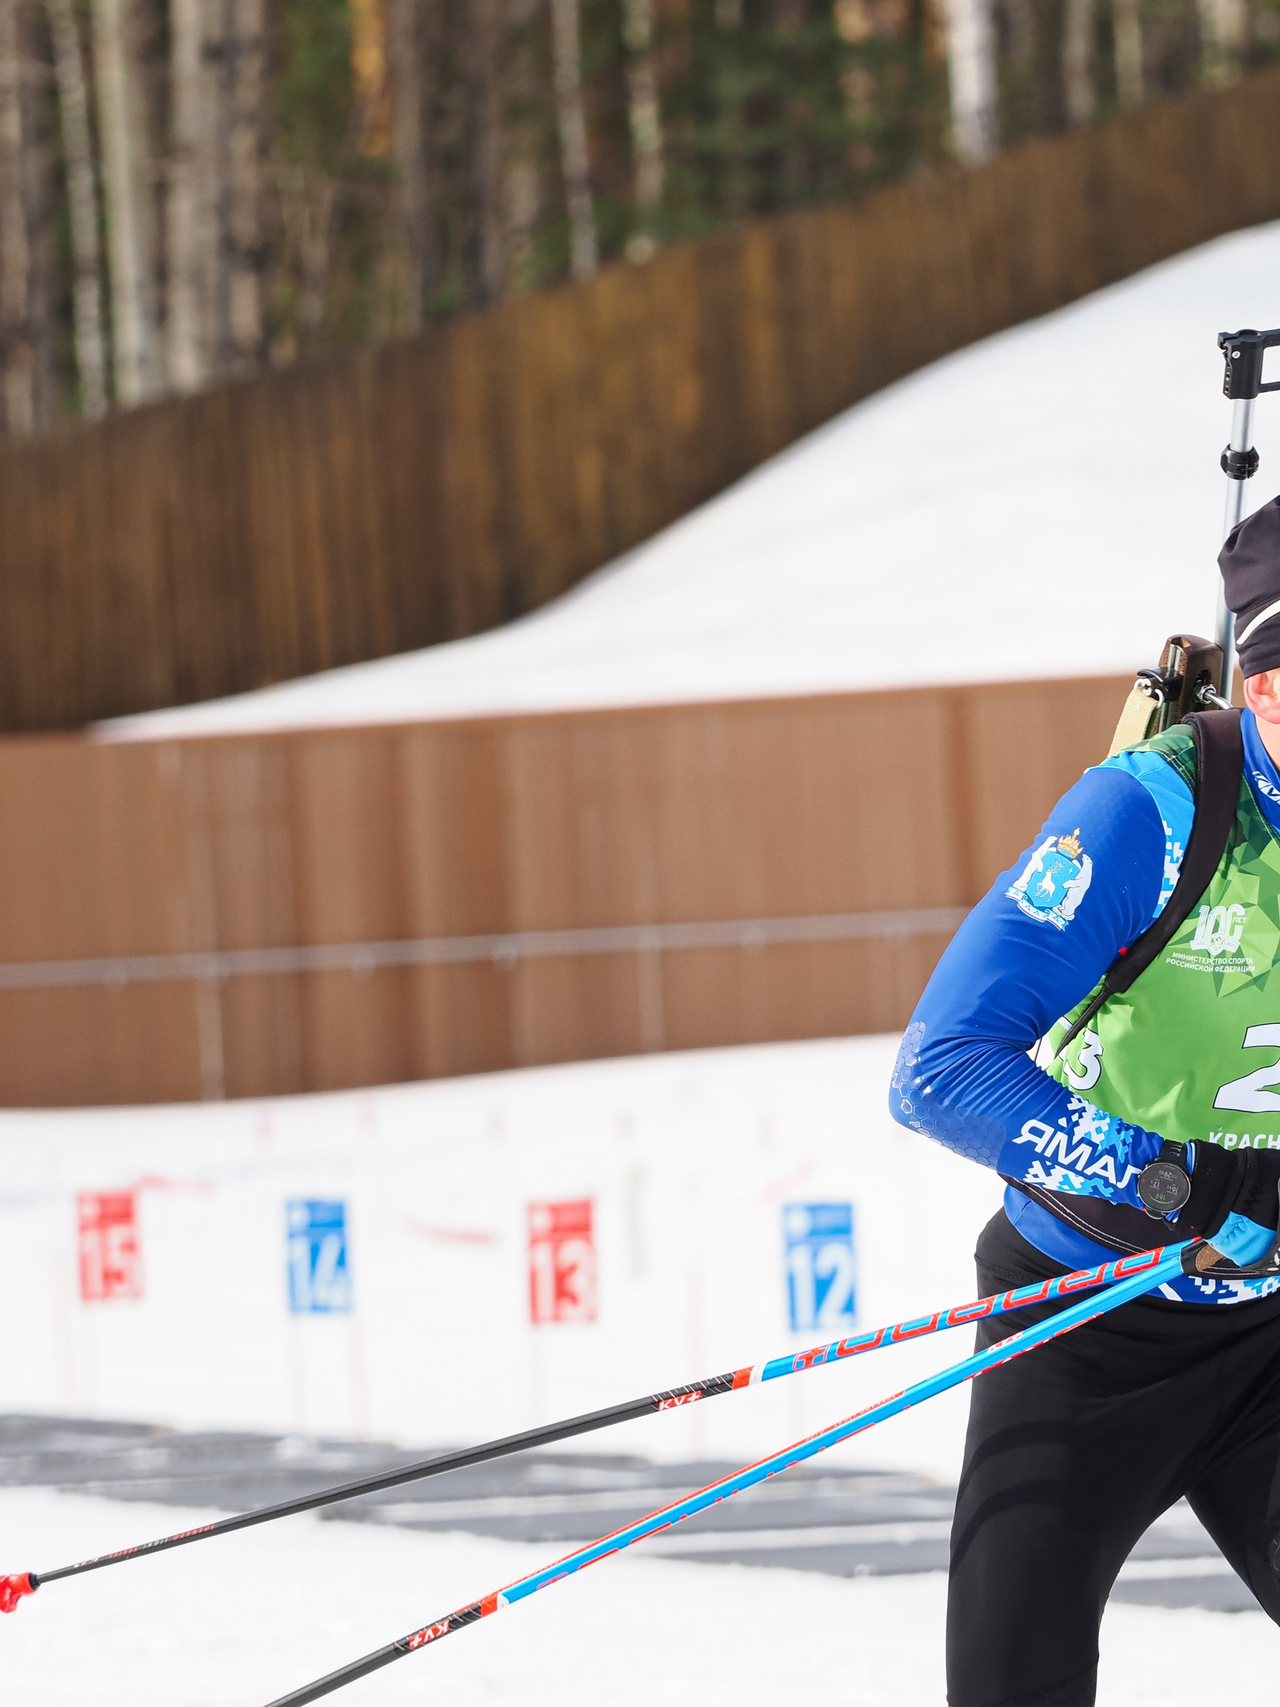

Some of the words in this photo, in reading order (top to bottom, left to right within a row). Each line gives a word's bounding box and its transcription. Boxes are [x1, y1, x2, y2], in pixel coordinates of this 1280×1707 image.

[1232, 916, 1247, 924] ЛЕТ
[1166, 957, 1213, 973] РОССИЙСКОЙ
[1214, 964, 1255, 974] ФЕДЕРАЦИИ
[1172, 951, 1226, 965] МИНИСТЕРСТВО
[1228, 957, 1254, 965] СПОРТА
[1056, 1017, 1105, 1091] 3
[79, 1226, 143, 1300] 15
[288, 1233, 351, 1309] 14
[530, 1238, 598, 1320] 13
[788, 1243, 856, 1328] 12
[657, 1391, 701, 1411] KV+
[409, 1619, 450, 1649] KV+
